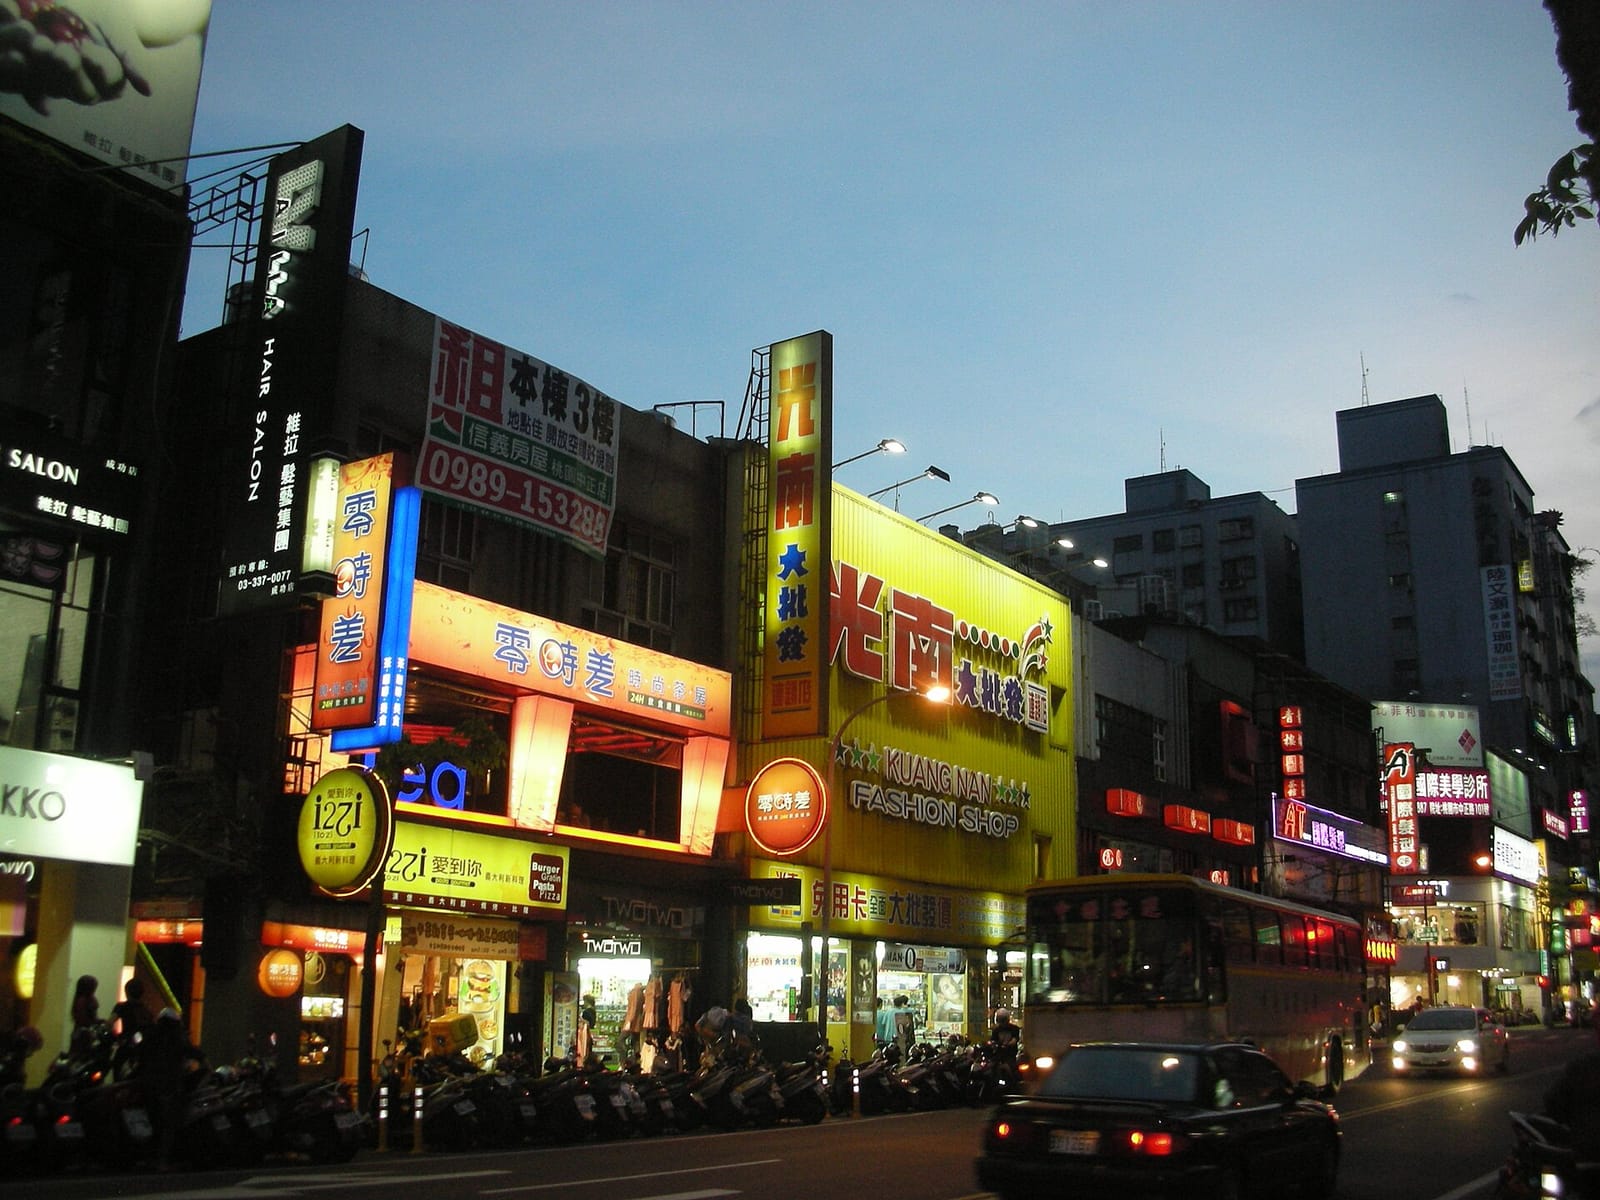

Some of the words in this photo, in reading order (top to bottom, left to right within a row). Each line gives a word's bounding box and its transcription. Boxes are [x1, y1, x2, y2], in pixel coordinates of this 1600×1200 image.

[258, 337, 276, 398] HAIR
[434, 321, 506, 424] 租
[507, 408, 544, 441] 地點佳
[509, 354, 615, 447] 本棟3樓
[247, 410, 267, 502] SALON
[283, 411, 302, 457] 維拉
[469, 422, 548, 473] 信義房屋
[774, 362, 816, 532] 光南
[8, 448, 80, 487] SALON
[273, 462, 297, 553] 髮藝集團
[237, 570, 292, 591] 03-337-0077
[776, 543, 809, 662] 大批發
[494, 622, 617, 698] 零時差
[829, 560, 955, 704] 光南
[955, 658, 1024, 723] 大批發
[884, 746, 952, 793] KUANG
[954, 766, 993, 805] NAN
[1416, 773, 1488, 800] 國際美學診所
[852, 780, 957, 828] FASHION
[959, 805, 1019, 838] SHOP
[432, 856, 482, 878] 愛到你
[532, 862, 560, 875] Burger
[533, 879, 555, 892] Pasta
[539, 890, 561, 902] Pizza
